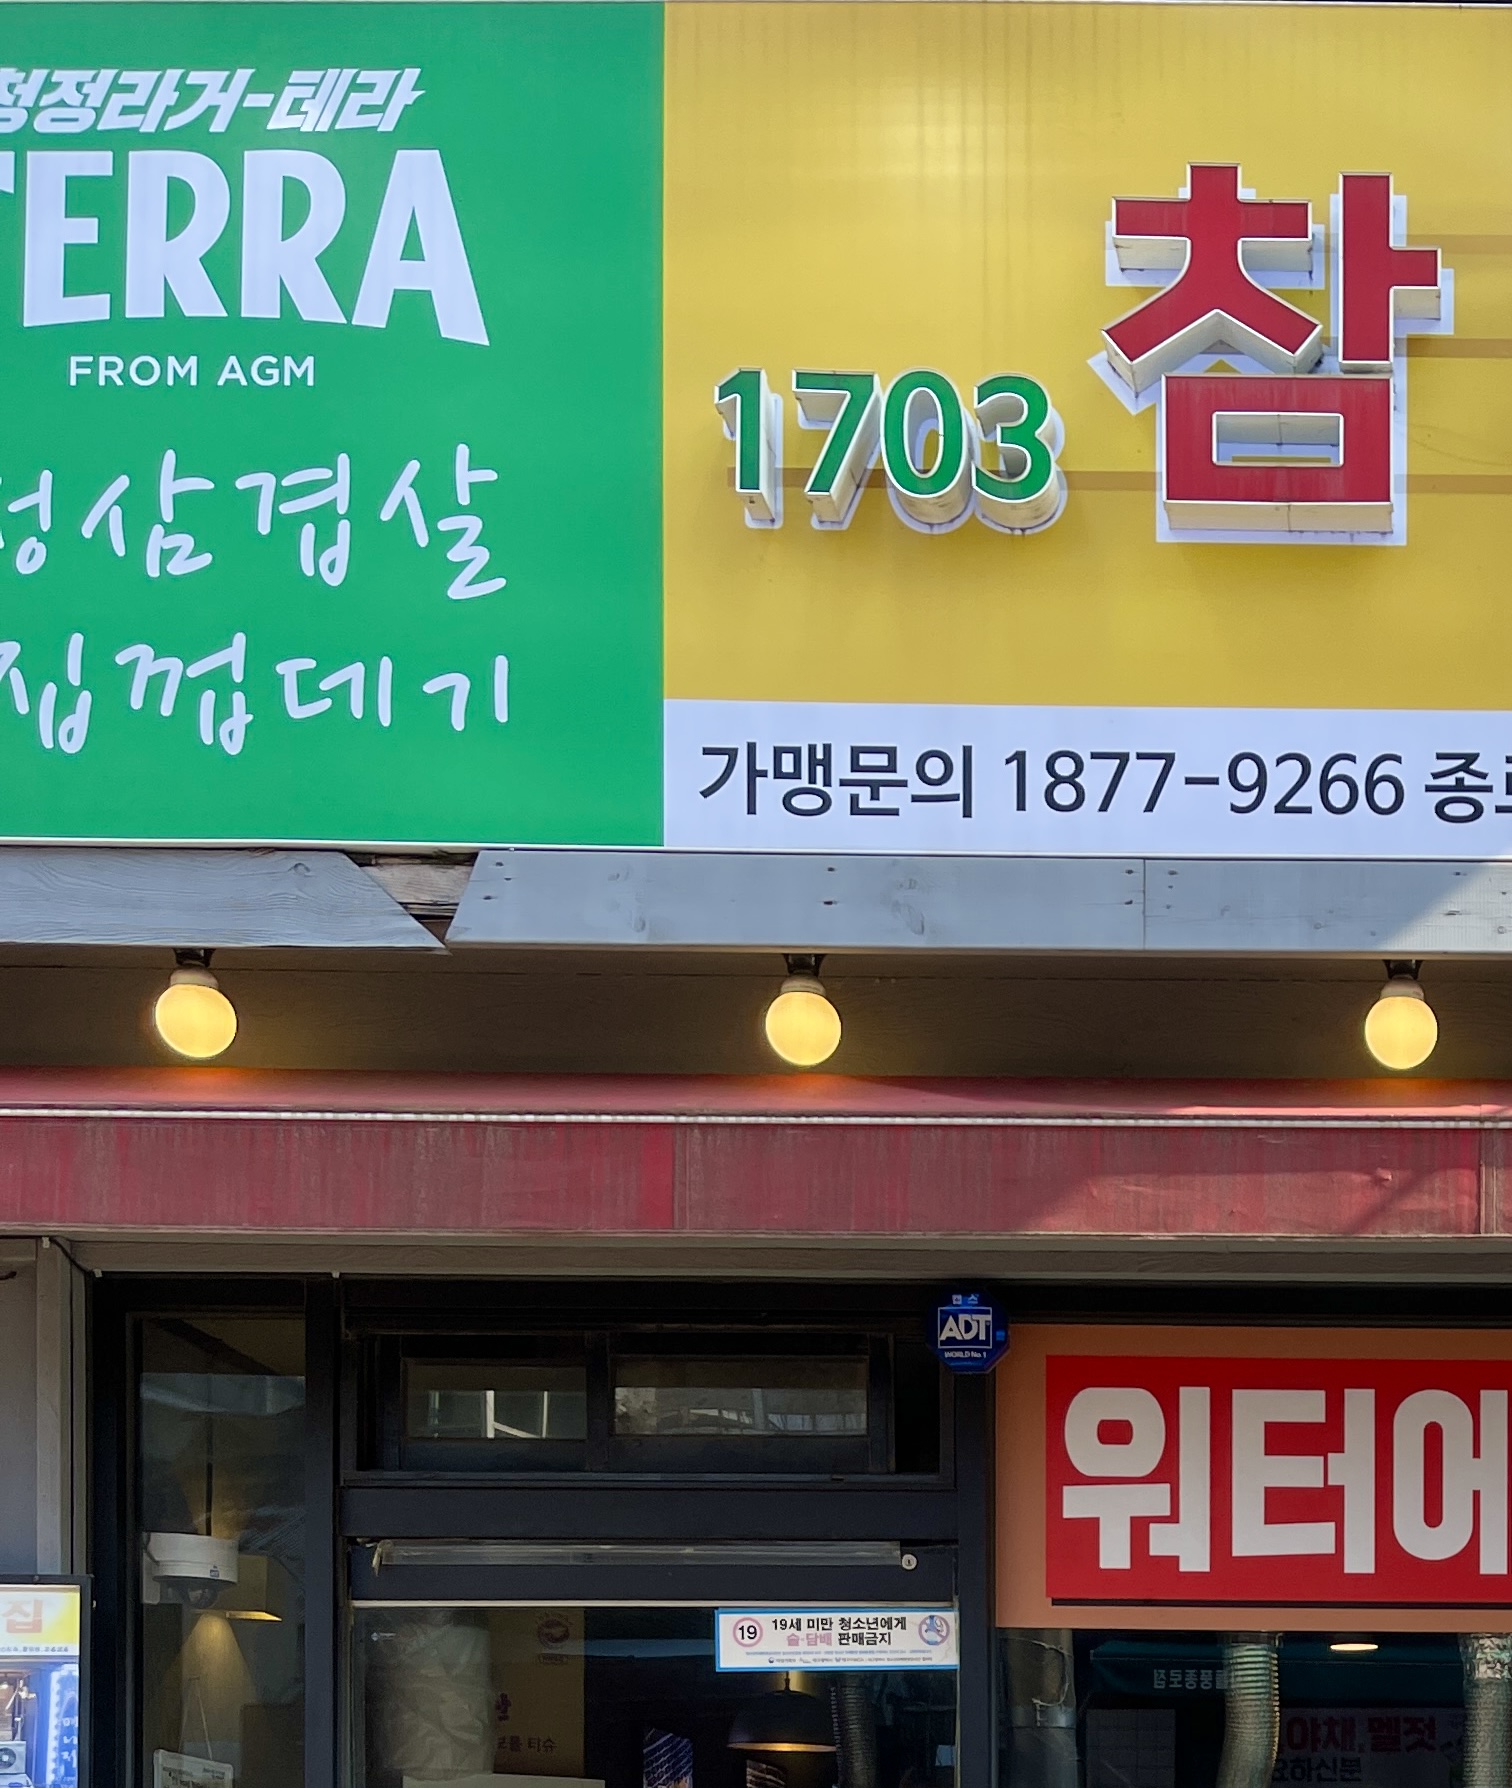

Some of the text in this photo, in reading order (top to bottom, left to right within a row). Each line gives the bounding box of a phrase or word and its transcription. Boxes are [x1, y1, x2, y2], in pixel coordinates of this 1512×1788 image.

[0, 149, 489, 346] ERRA
[69, 356, 315, 387] FROM AGM
[714, 368, 1060, 525] 1703
[699, 741, 974, 819] 가맹문의
[1003, 749, 1404, 815] 1877-9266
[940, 1313, 992, 1341] ADT
[738, 1624, 757, 1640] 19
[771, 1616, 907, 1631] 19세 미만 청소년에게
[838, 1632, 891, 1646] 판매금지
